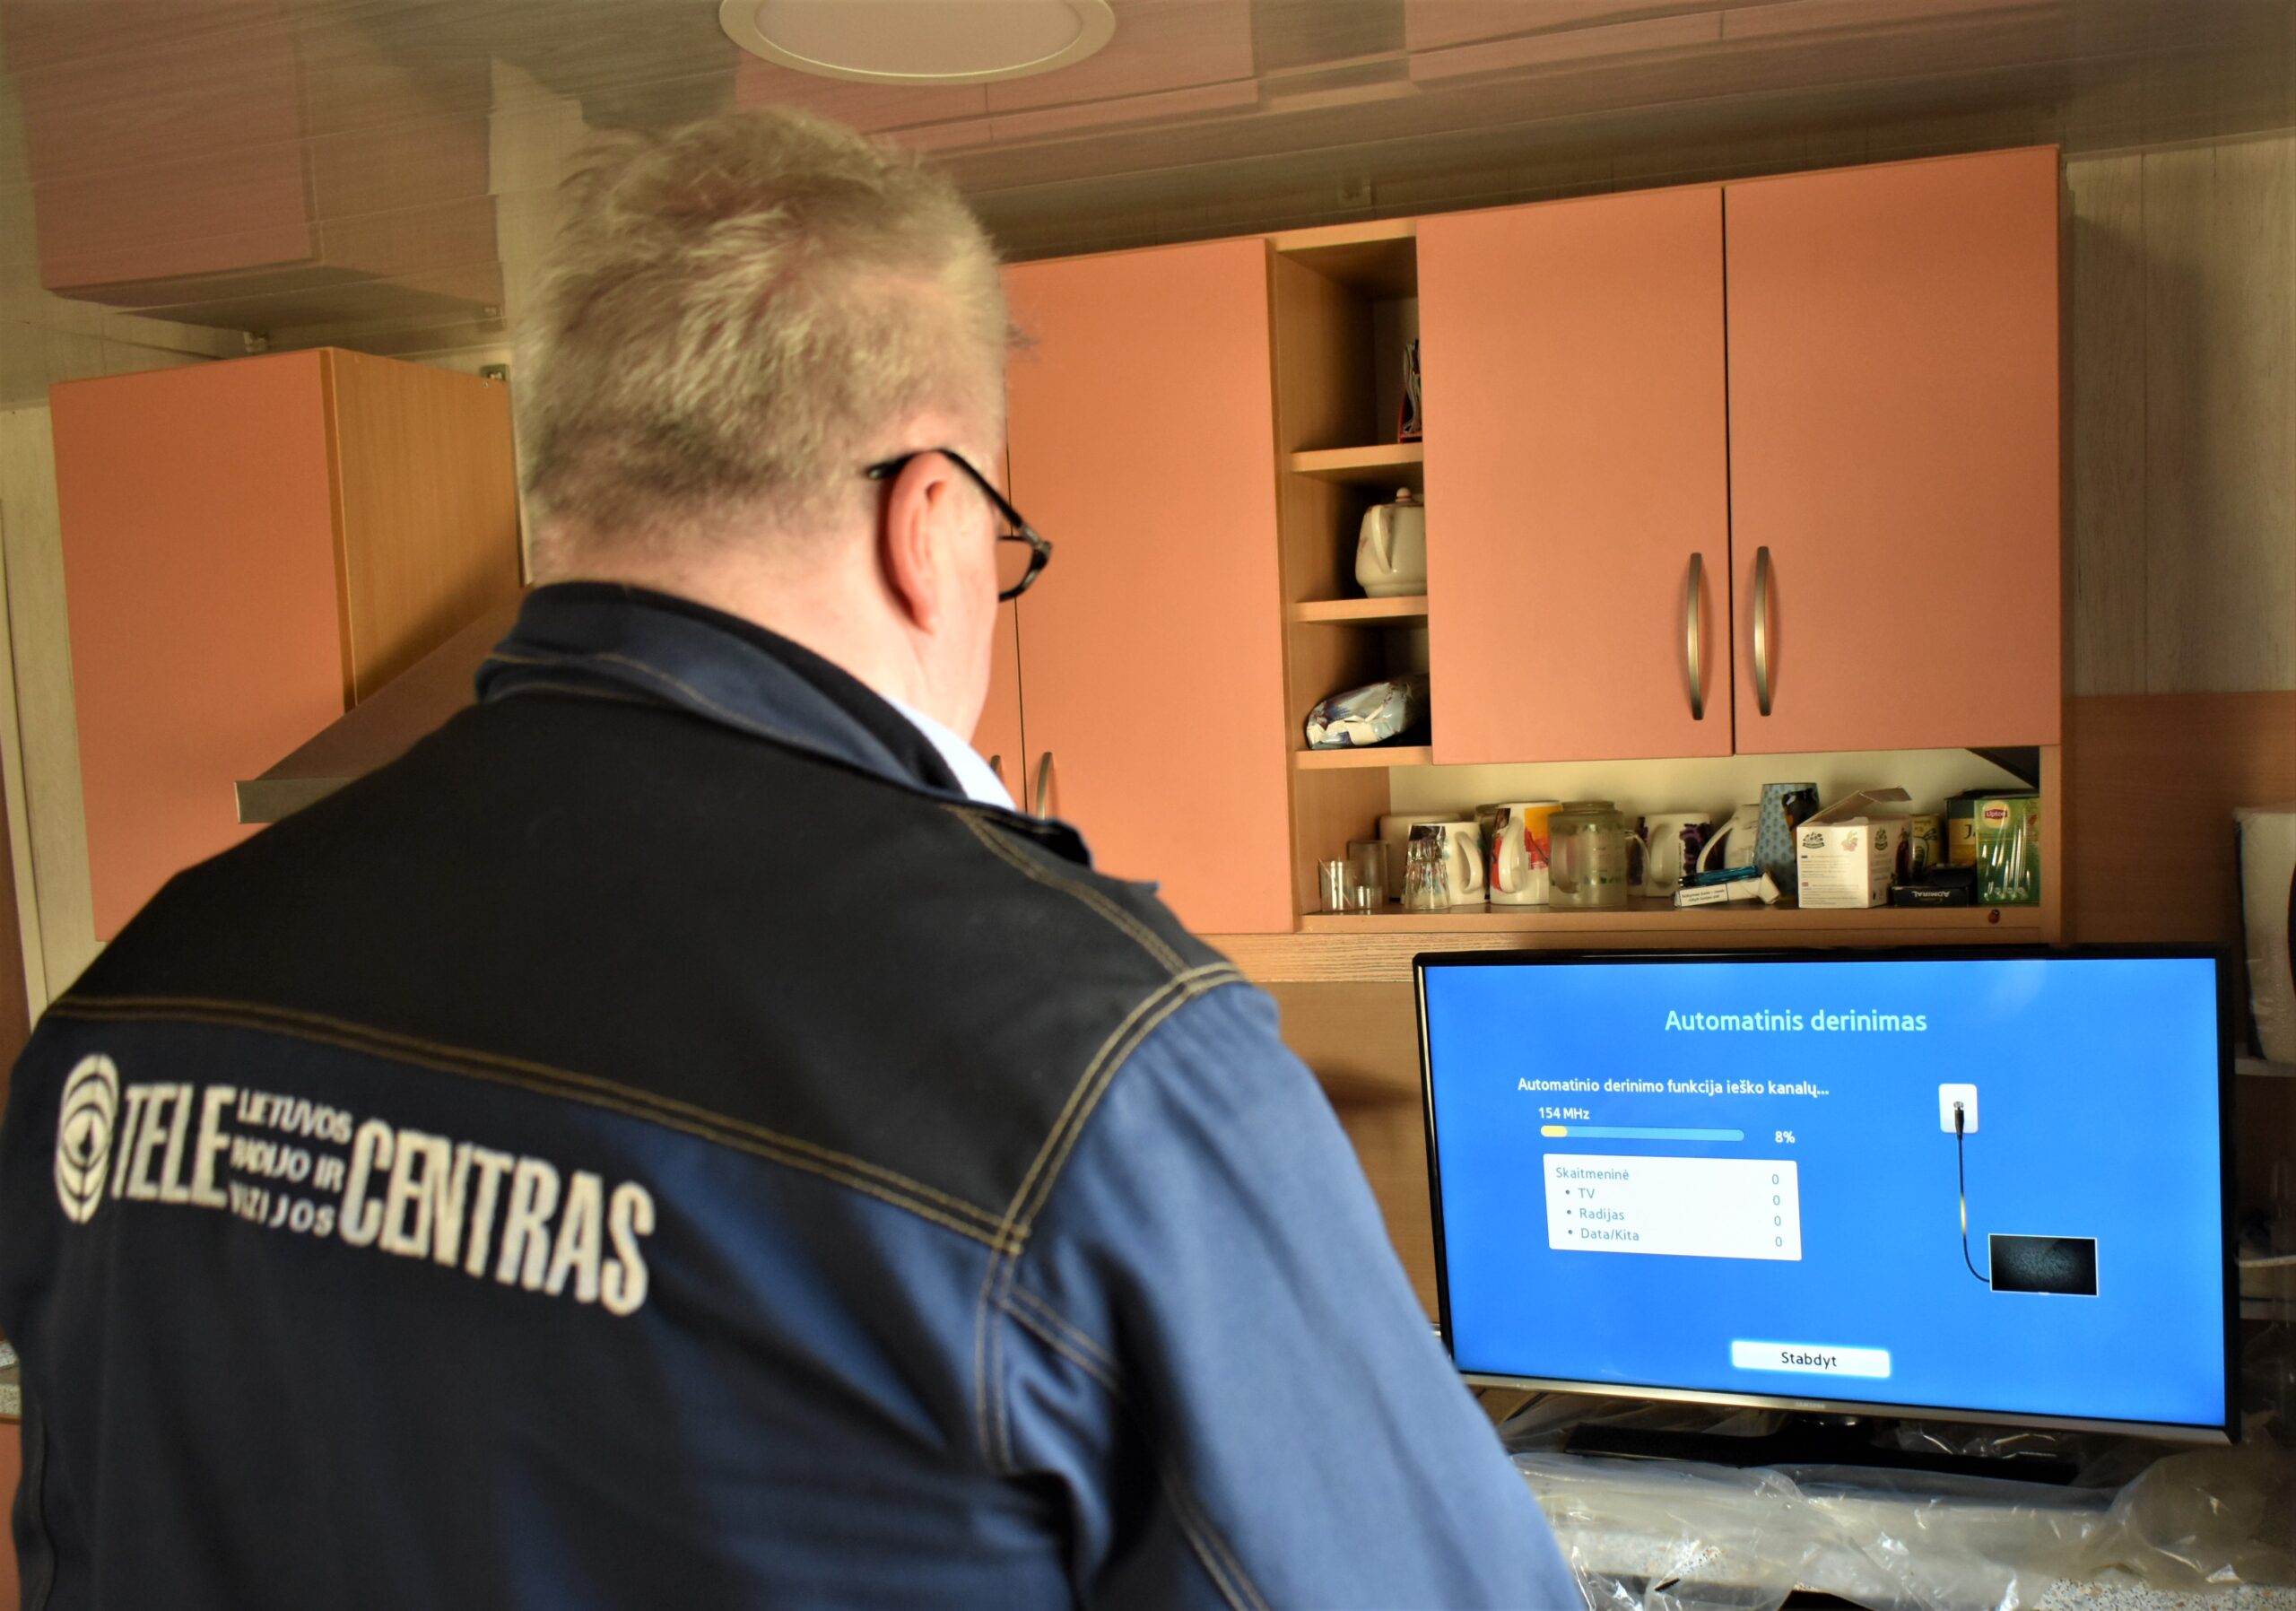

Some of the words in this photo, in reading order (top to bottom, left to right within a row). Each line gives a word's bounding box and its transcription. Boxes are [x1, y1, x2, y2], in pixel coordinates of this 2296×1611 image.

[1665, 1009, 1804, 1032] Automatinis
[1810, 1008, 1927, 1032] derinimas
[1518, 1077, 1600, 1093] Automatinio
[1604, 1078, 1665, 1093] derinimo
[1667, 1078, 1723, 1096] funkcija
[1726, 1079, 1765, 1094] ieško
[1768, 1080, 1830, 1098] kanalų...
[237, 1088, 353, 1145] LIETUVOS
[1538, 1106, 1561, 1119] 154
[1562, 1107, 1590, 1120] MHz
[1774, 1130, 1796, 1144] 8%
[112, 1083, 237, 1208] TELE
[312, 1154, 345, 1194] IR
[1555, 1166, 1630, 1180] Skaitmeninė
[1771, 1173, 1779, 1185] 0
[1578, 1188, 1596, 1199] TV
[1772, 1194, 1780, 1206] 0
[338, 1118, 655, 1317] CENTRAS
[1578, 1207, 1625, 1223] Radijas
[1773, 1215, 1782, 1227] 0
[1580, 1227, 1639, 1242] Data/Kita
[1775, 1235, 1783, 1248] 0
[1781, 1351, 1838, 1369] Stabdyt
